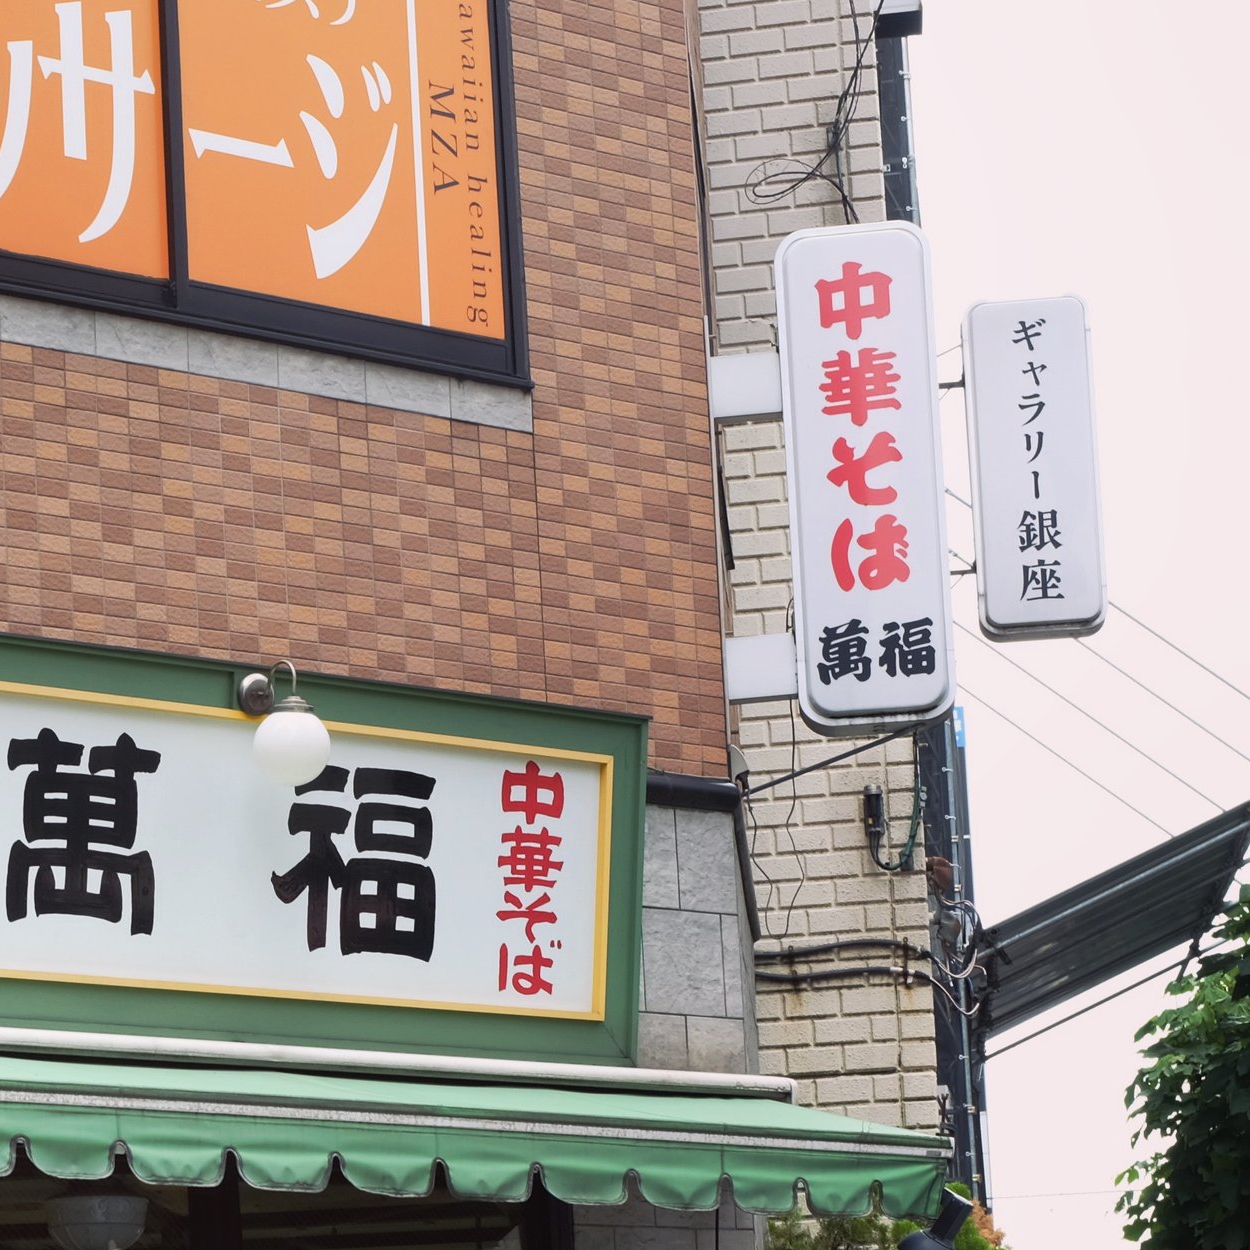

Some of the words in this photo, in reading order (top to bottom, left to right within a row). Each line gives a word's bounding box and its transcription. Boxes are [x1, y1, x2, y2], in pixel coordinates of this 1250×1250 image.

[427, 80, 460, 197] MZA
[466, 175, 490, 328] healing
[814, 261, 911, 593] 中華そば
[1011, 318, 1066, 602] ギャラリー銀座
[816, 616, 937, 686] 萬福
[5, 727, 438, 963] 萬福
[495, 760, 564, 997] 中華そば
